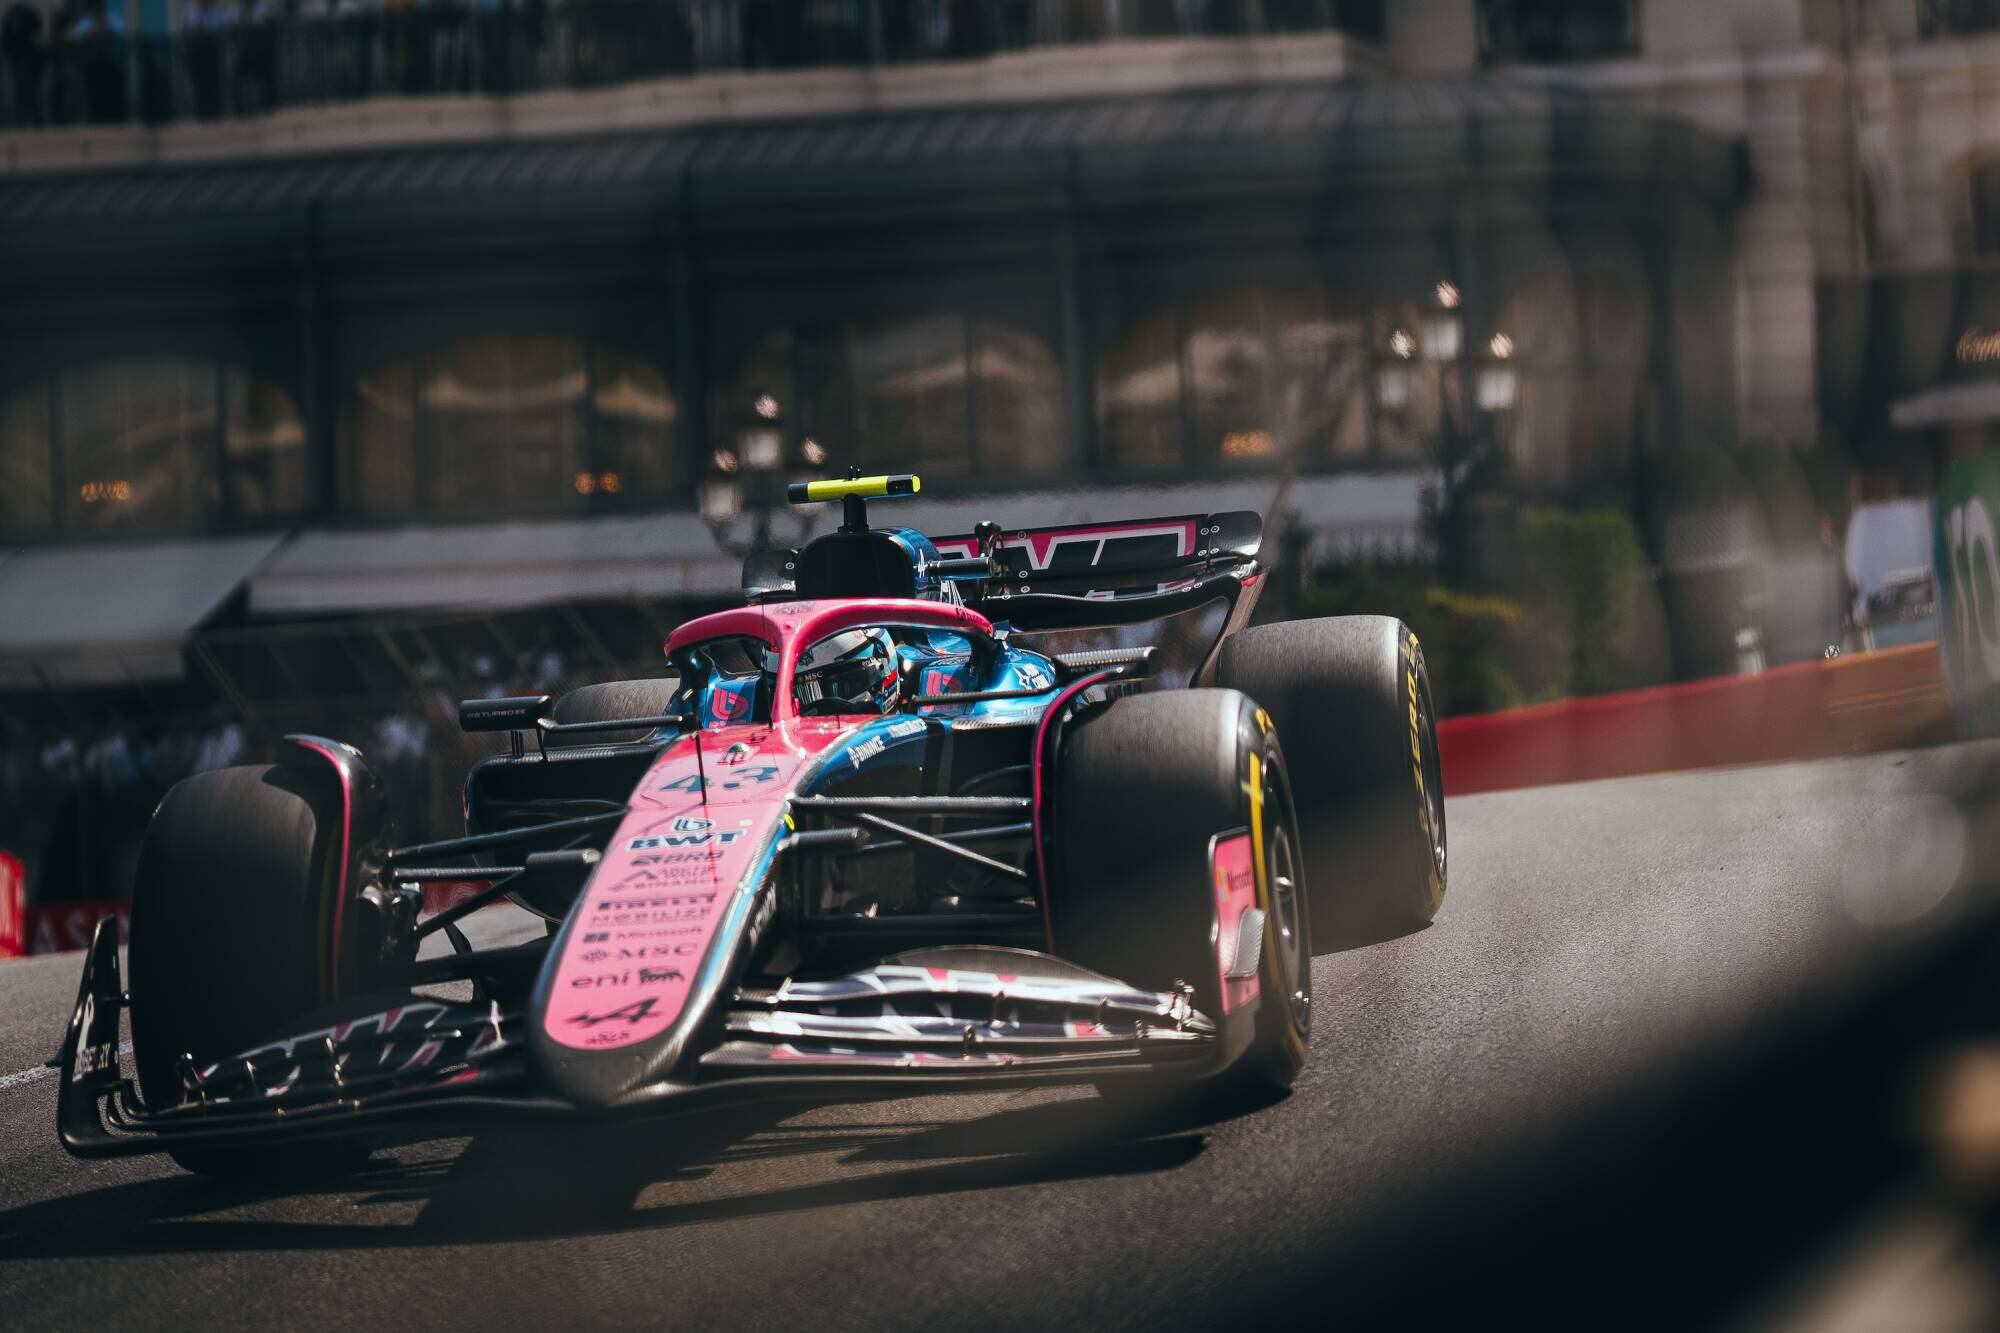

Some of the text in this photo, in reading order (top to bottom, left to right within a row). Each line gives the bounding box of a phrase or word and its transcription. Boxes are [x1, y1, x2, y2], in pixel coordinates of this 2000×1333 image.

[804, 671, 823, 681] MSC
[659, 766, 780, 794] 43
[629, 830, 745, 850] BWT
[597, 893, 717, 911] PIRELLI
[617, 943, 699, 961] MSC
[571, 968, 632, 988] eni
